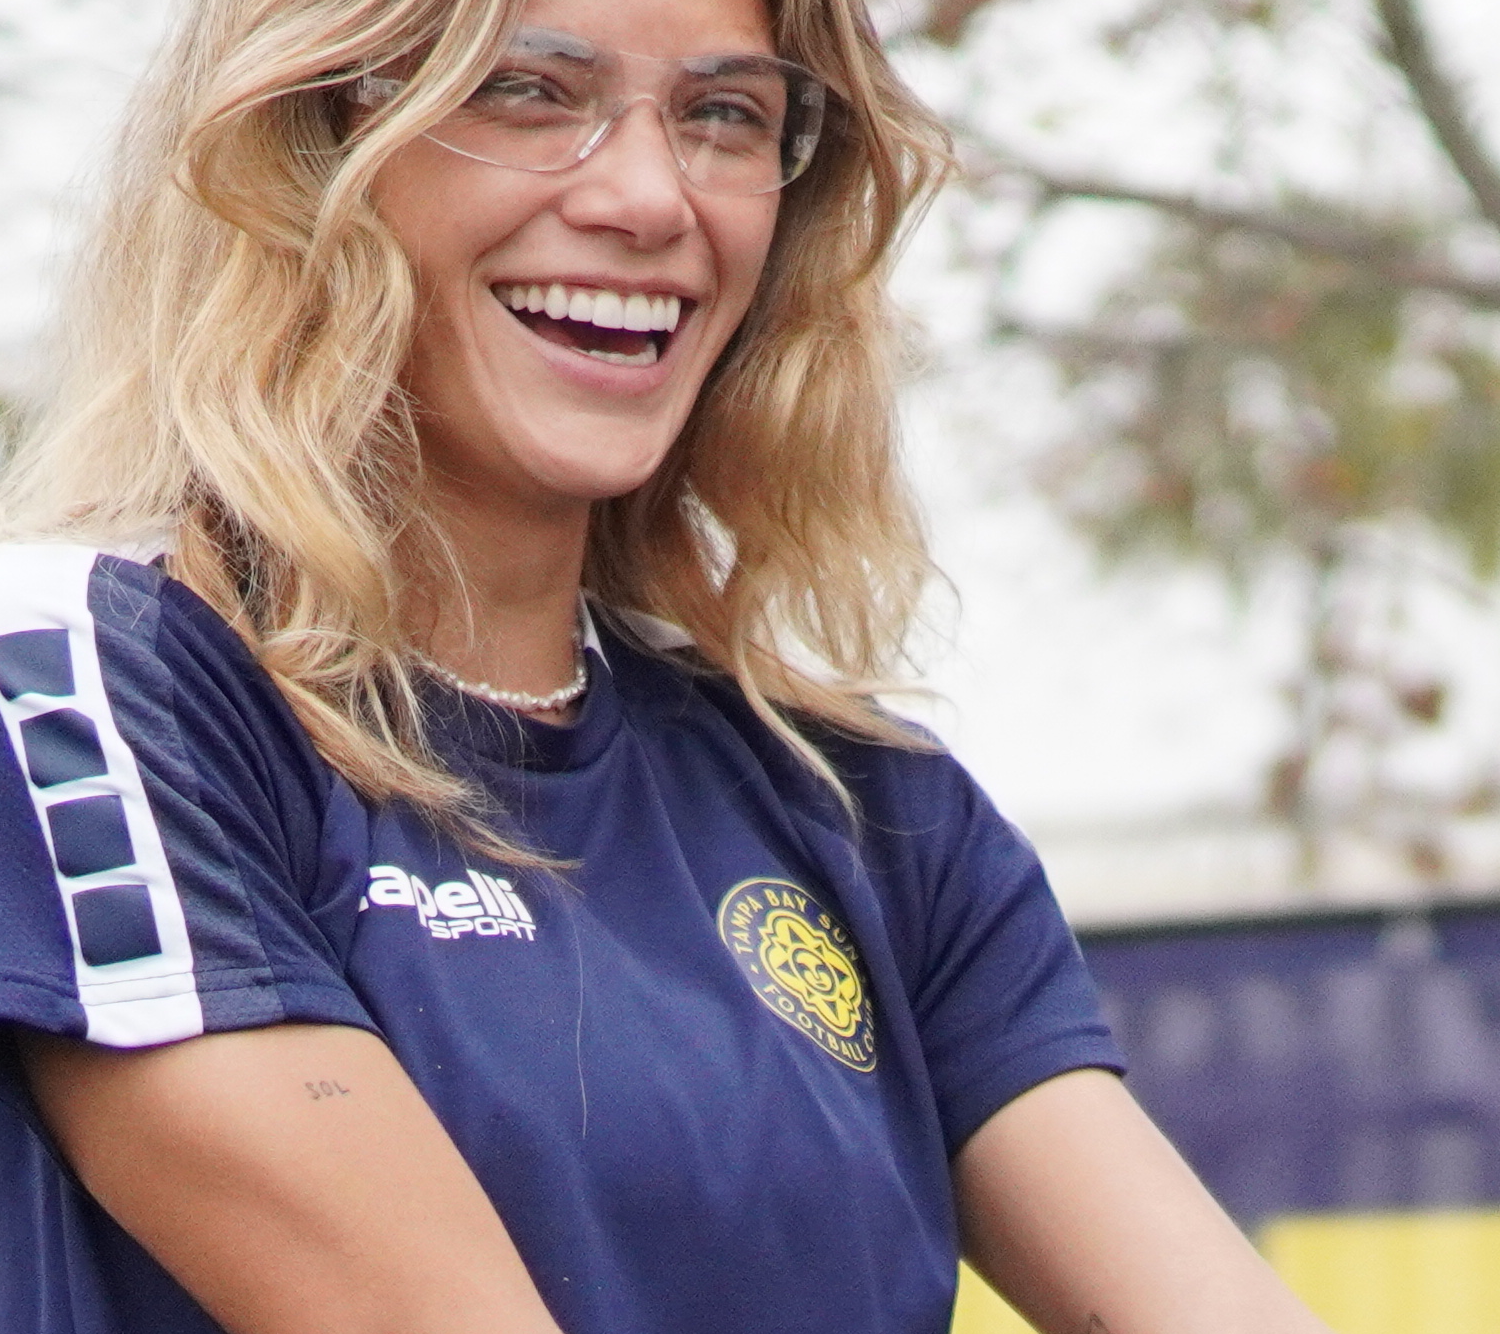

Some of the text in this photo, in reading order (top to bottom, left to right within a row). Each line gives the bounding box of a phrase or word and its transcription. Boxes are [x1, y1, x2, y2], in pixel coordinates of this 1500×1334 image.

[359, 865, 533, 927] apelli
[428, 917, 537, 942] SPORT
[731, 889, 859, 961] TAMPA BAY SUN
[763, 985, 867, 1062] FOOTBALL
